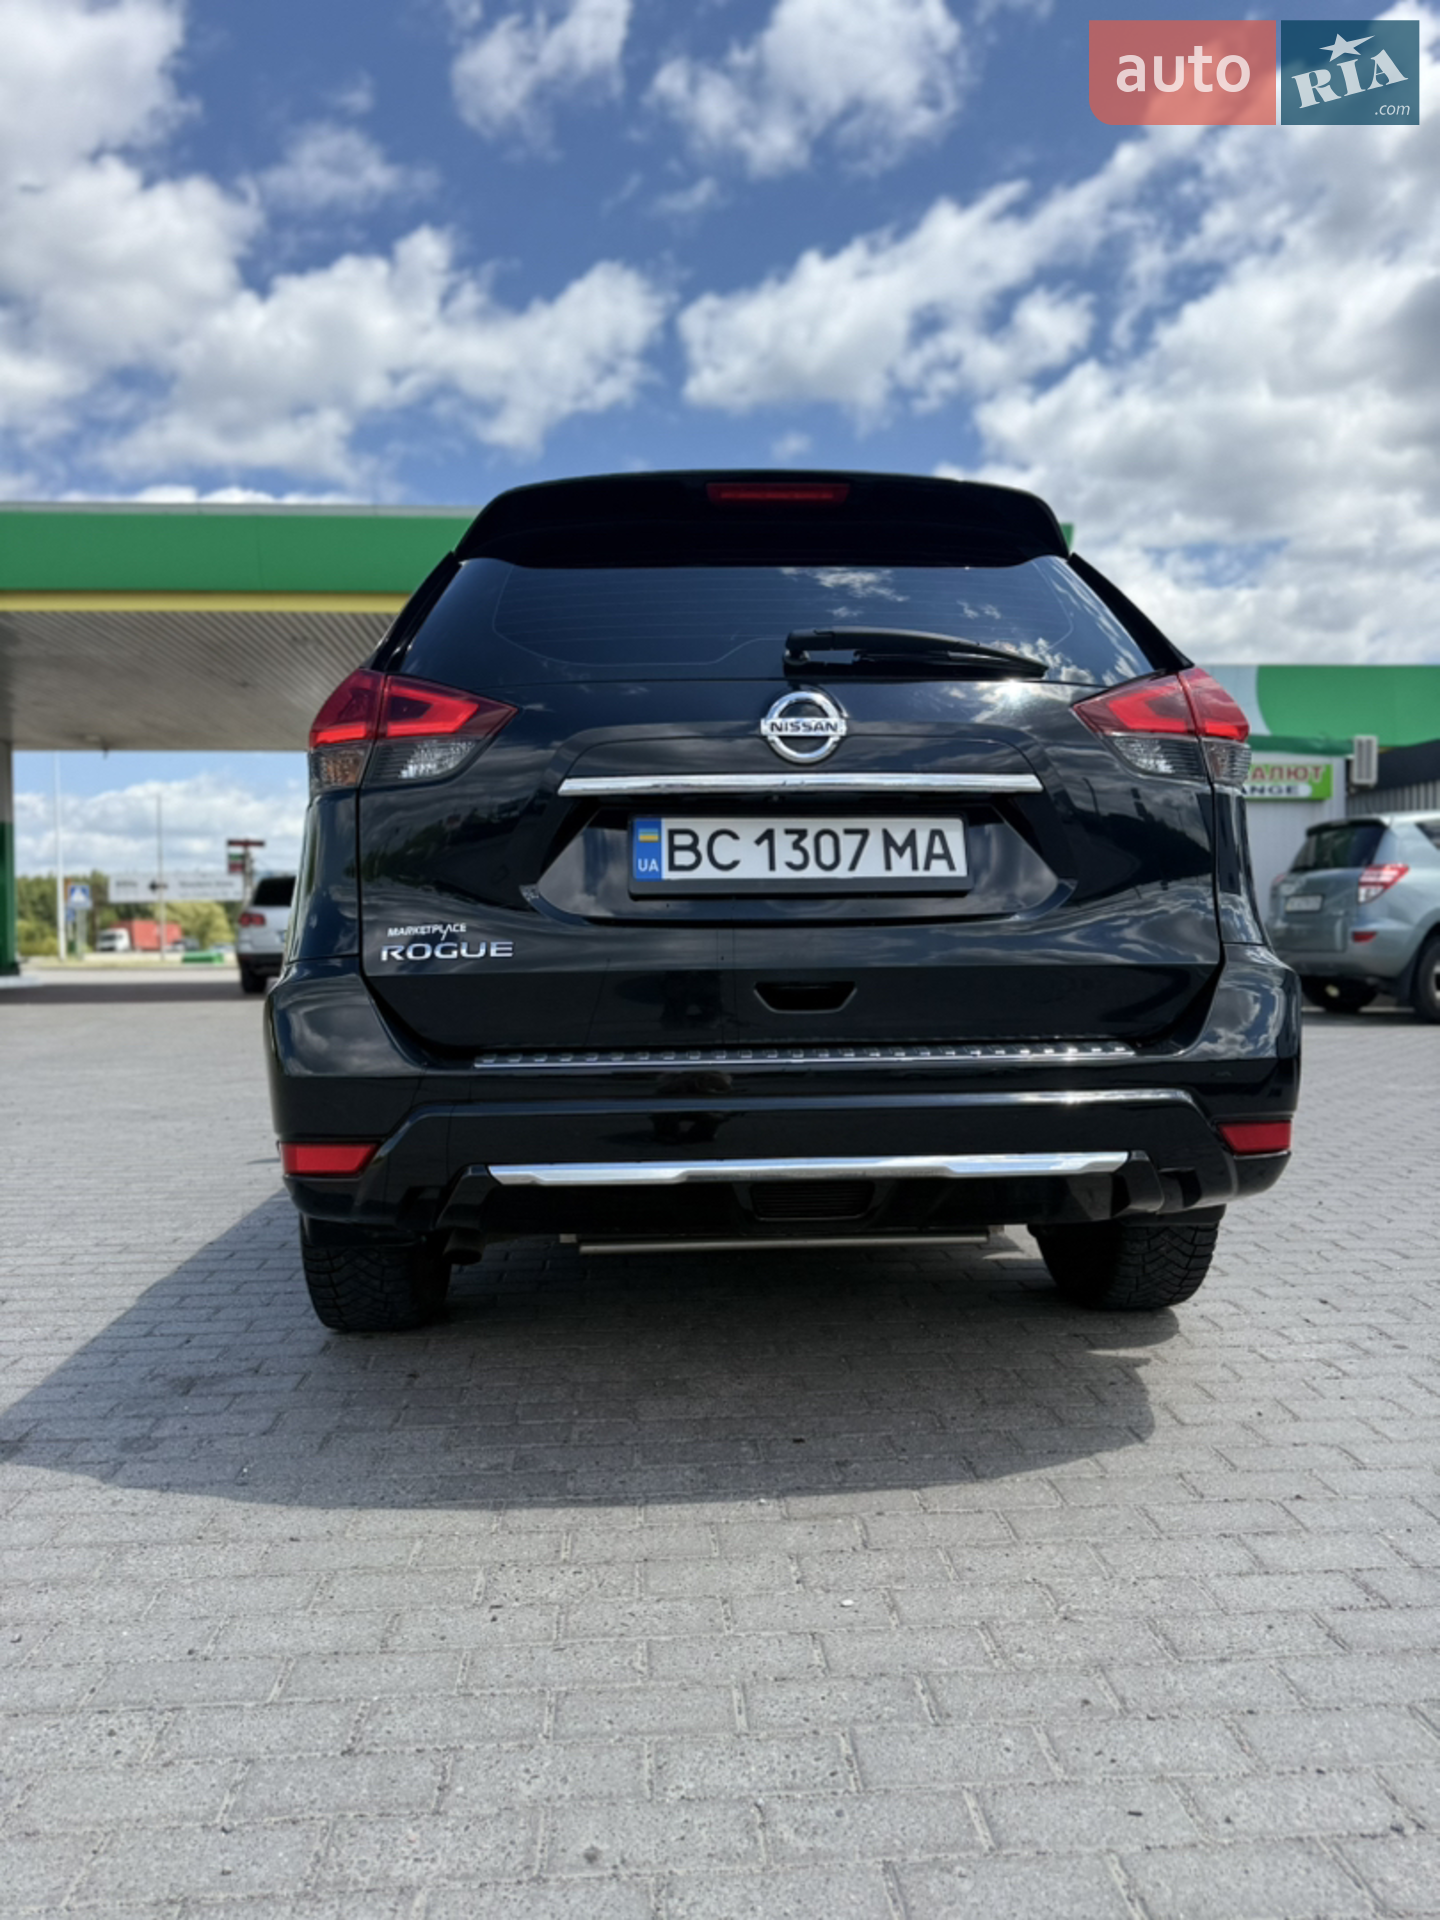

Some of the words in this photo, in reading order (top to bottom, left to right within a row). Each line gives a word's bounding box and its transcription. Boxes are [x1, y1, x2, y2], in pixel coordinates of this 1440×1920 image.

[770, 721, 838, 732] NISSAN
[667, 828, 741, 872] BC
[754, 828, 870, 872] 1307
[882, 828, 957, 872] MA
[638, 858, 659, 872] UA
[387, 923, 466, 941] MARKETPLACE
[380, 941, 514, 961] ROGUE
